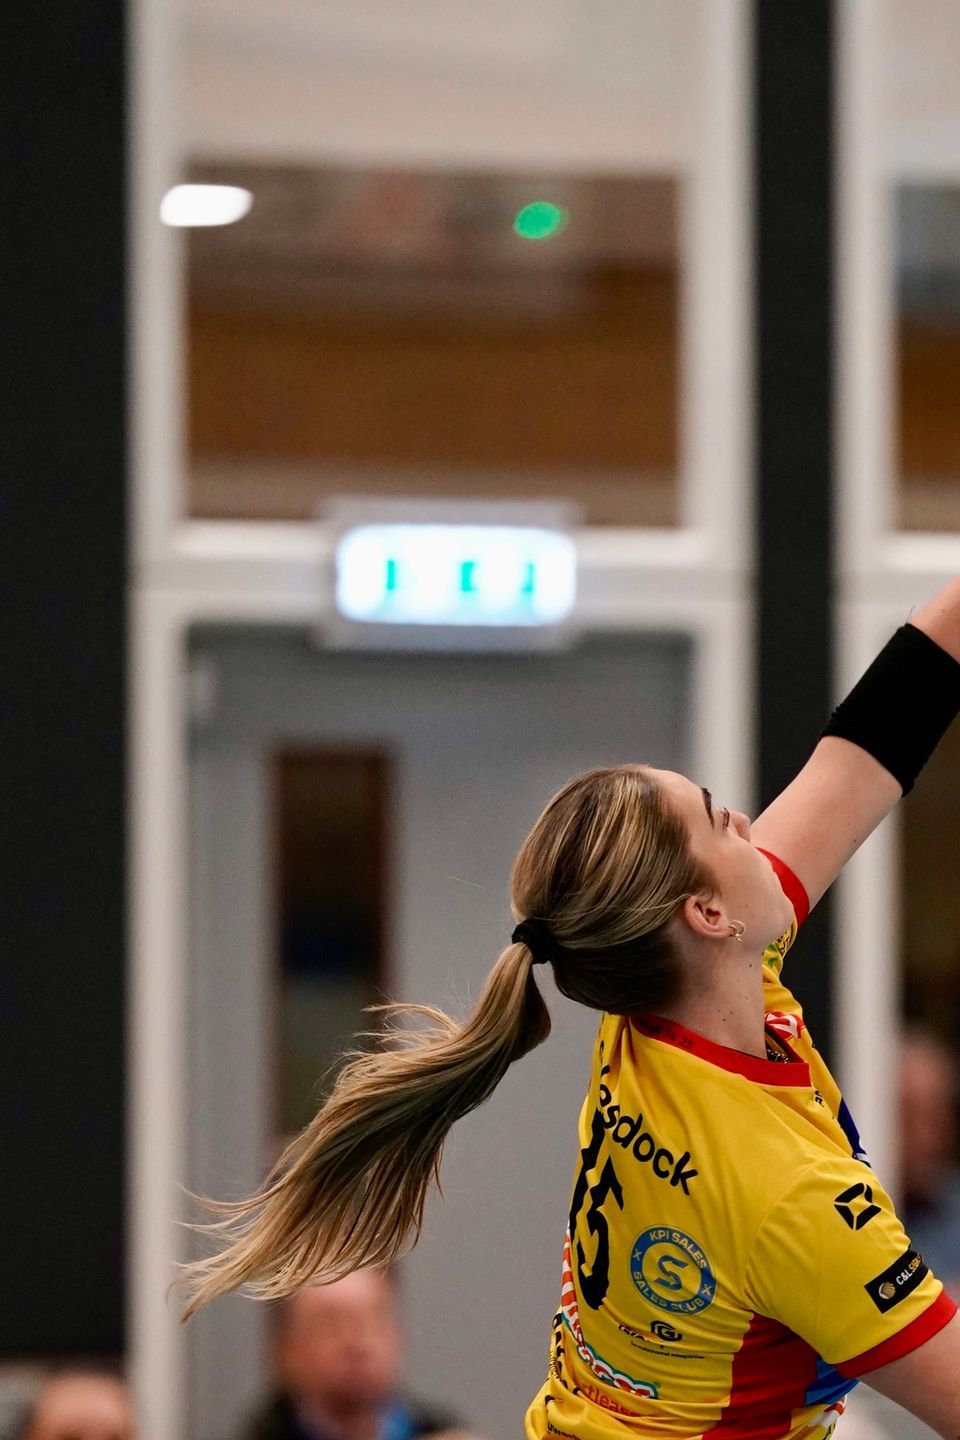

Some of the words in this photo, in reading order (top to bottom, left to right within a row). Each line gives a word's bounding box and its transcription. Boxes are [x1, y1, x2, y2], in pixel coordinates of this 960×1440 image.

[648, 1229, 670, 1241] KPI
[671, 1232, 707, 1269] SALES
[633, 1271, 668, 1307] SALES
[670, 1297, 705, 1312] CLUB
